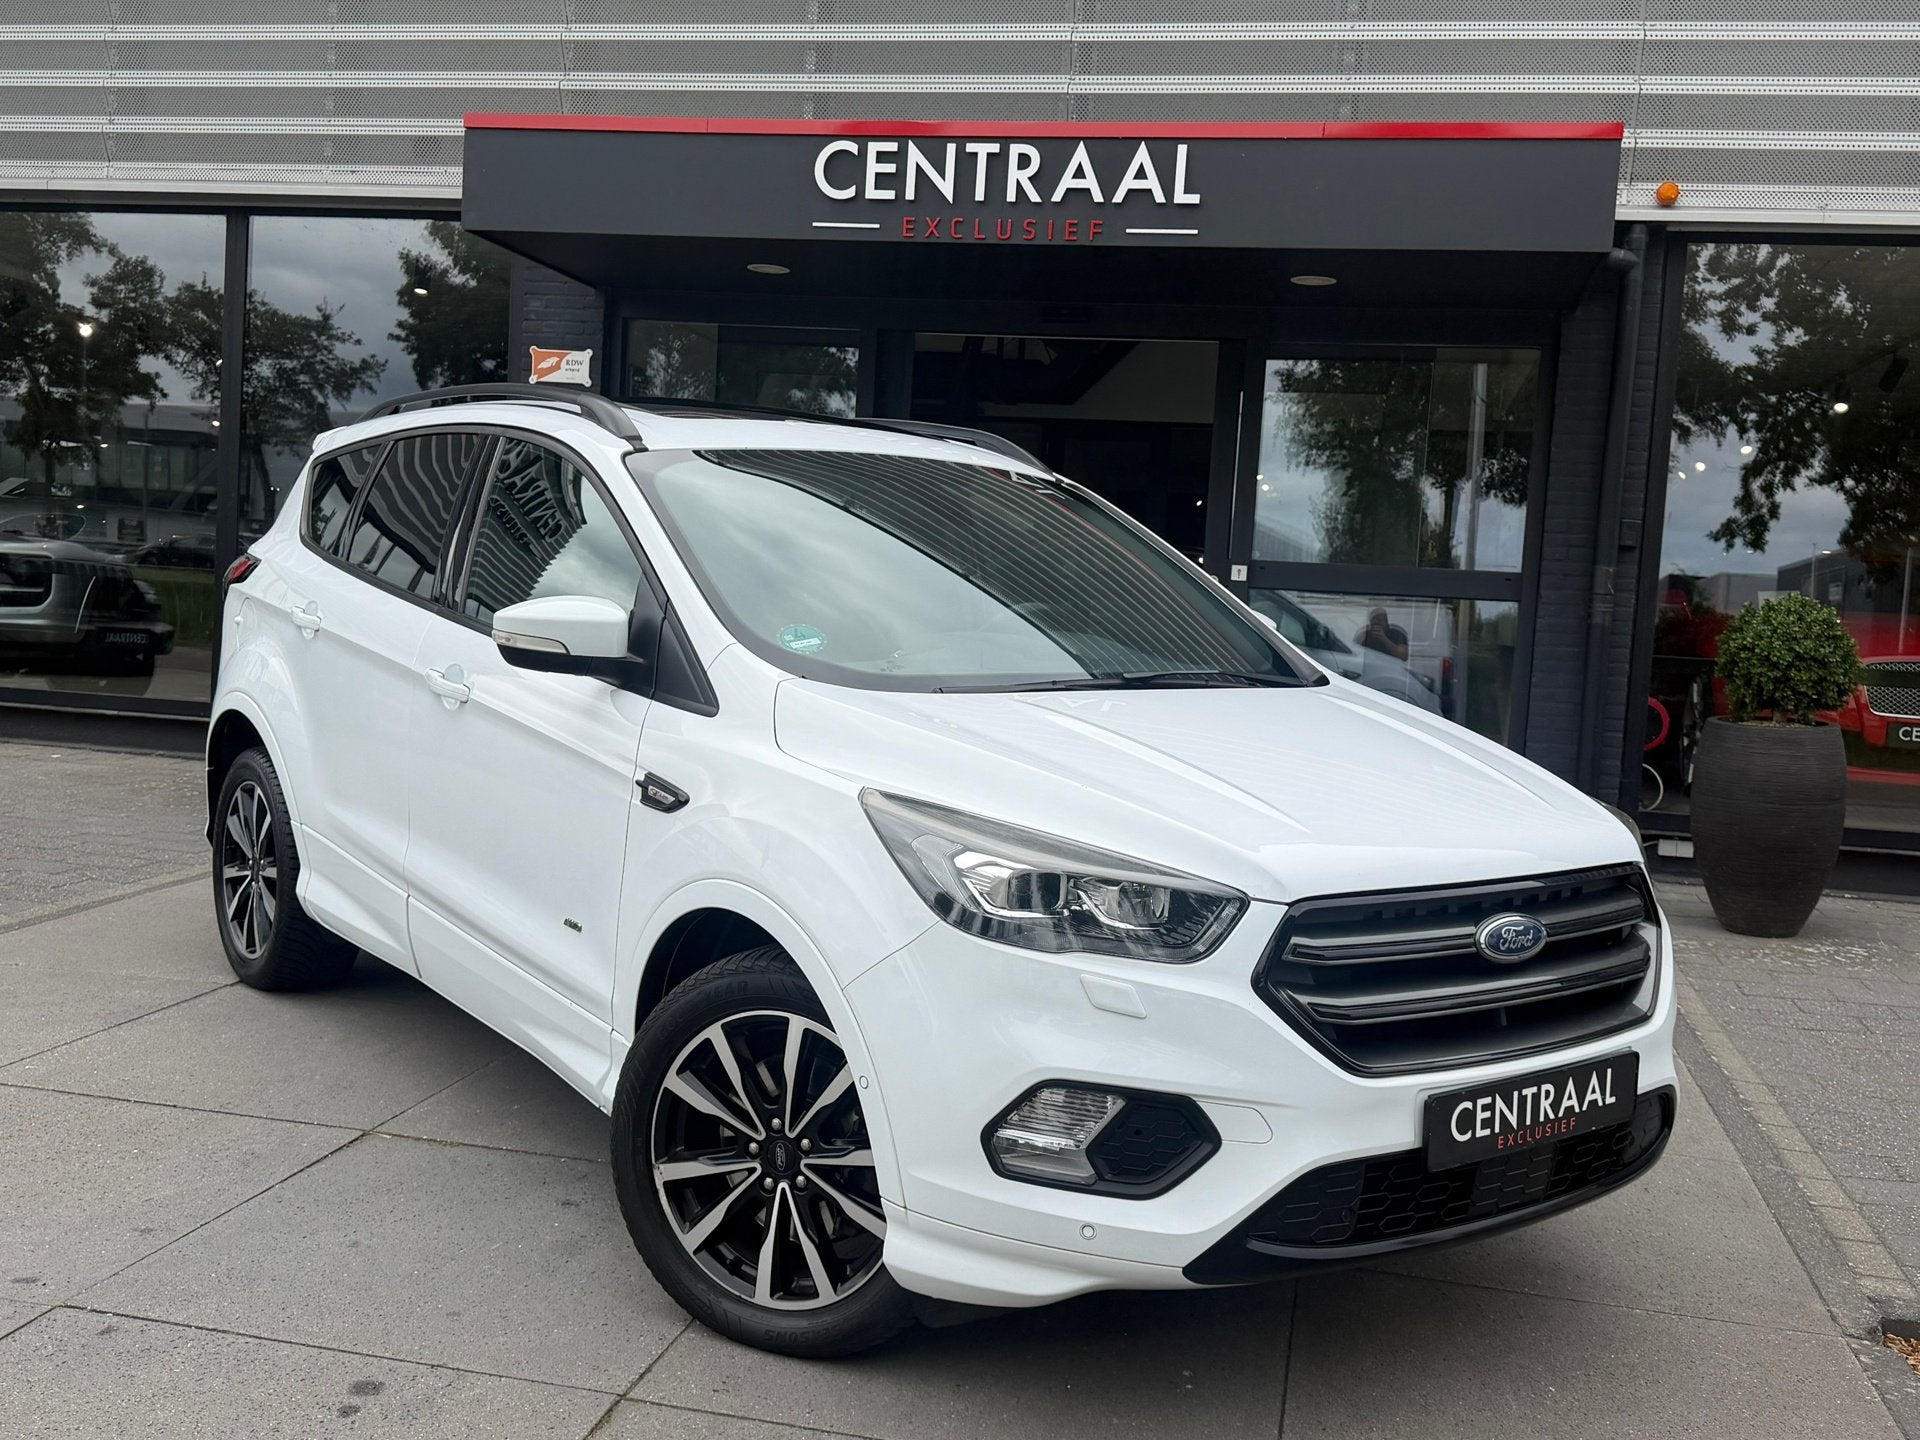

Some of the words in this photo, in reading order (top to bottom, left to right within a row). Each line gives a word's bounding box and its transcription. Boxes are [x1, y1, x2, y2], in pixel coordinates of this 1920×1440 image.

[814, 139, 1201, 204] CENTRAAL
[902, 217, 1104, 241] EXCLUSIEF
[1500, 925, 1534, 951] Ford
[1450, 1067, 1617, 1142] CENTRAAL
[1497, 1117, 1577, 1150] EXCLUSIEF
